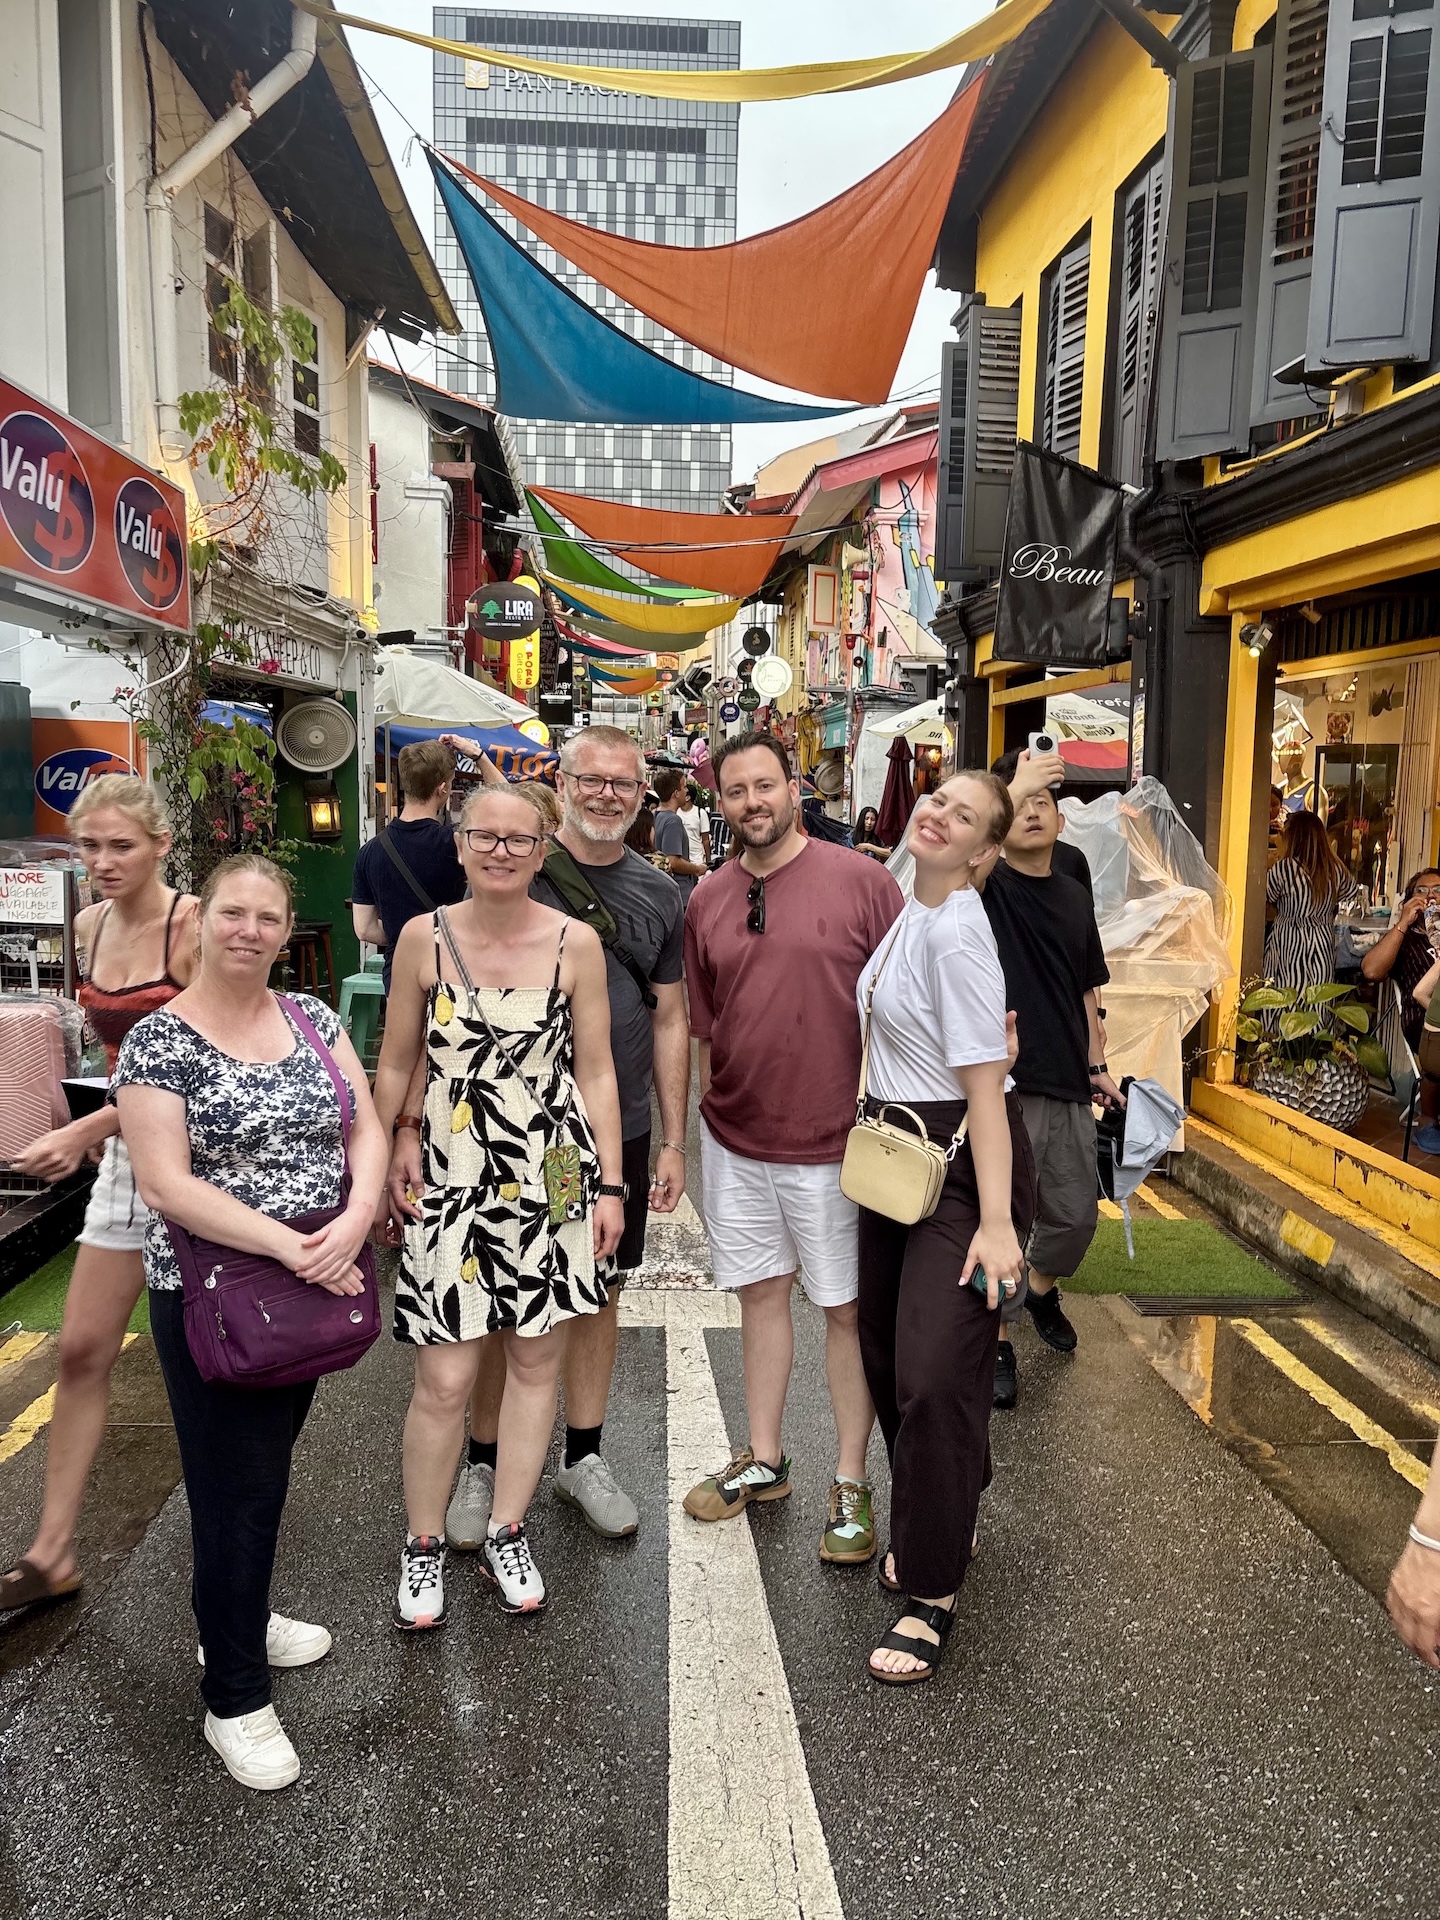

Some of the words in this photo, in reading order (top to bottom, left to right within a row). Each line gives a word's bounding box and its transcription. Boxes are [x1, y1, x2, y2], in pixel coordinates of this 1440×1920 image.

[1009, 542, 1104, 586] Beau
[505, 600, 534, 616] LIRA
[300, 640, 308, 678] &
[5, 872, 47, 884] MORE
[7, 910, 49, 920] INSIDE
